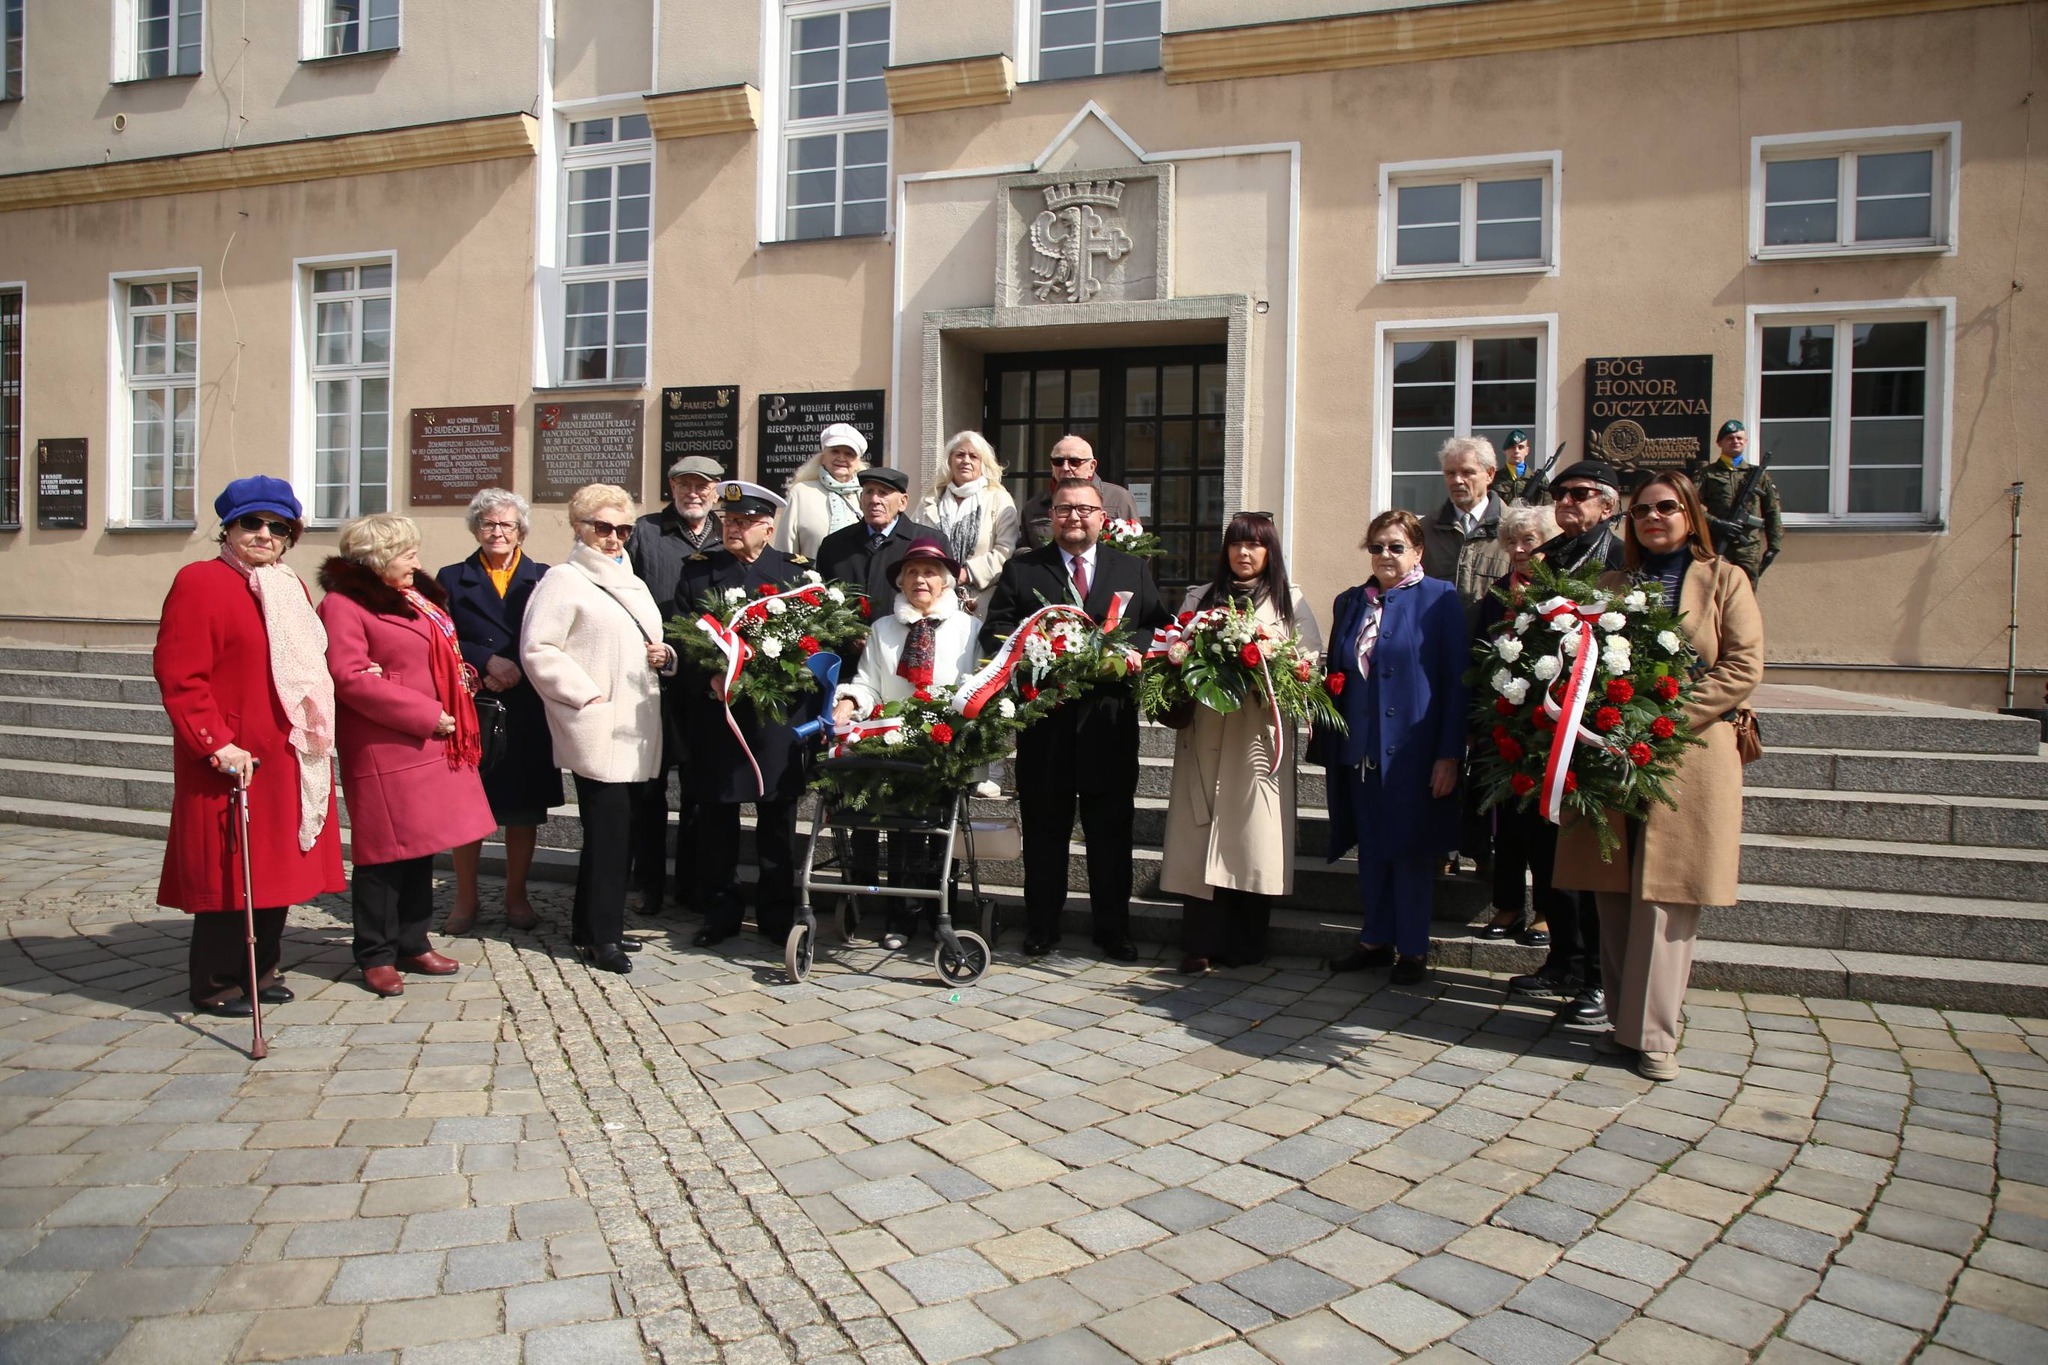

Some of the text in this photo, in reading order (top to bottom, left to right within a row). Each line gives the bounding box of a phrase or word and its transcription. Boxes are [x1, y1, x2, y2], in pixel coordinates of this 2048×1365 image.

[1595, 357, 1645, 376] BÓG
[1594, 379, 1678, 396] HONOR
[683, 401, 716, 410] PAMIĘCI
[788, 402, 874, 413] W HOŁDZIE POLEGŁYM
[1592, 398, 1710, 417] OJCZYZNA
[581, 412, 614, 420] HOŁDZIE
[805, 414, 814, 422] ZA
[424, 424, 500, 435] 10 SUDECKIEJ DYWIZJI
[543, 429, 590, 438] PANCERNEGO
[673, 430, 725, 438] WŁADYSŁAWA
[602, 435, 626, 444] BITWY
[627, 435, 634, 443] O
[785, 434, 821, 443] W LATAC
[543, 443, 634, 454] MONTE CASSINO ORAZ W
[665, 440, 733, 452] SIKORSKIEGO
[1644, 443, 1700, 452] INWALIDOM
[584, 452, 634, 460] PRZEKAZANIA
[1641, 451, 1697, 460] WOJENNYM
[548, 468, 628, 476] ZMECHANIZOWANEMU
[591, 476, 599, 484] W
